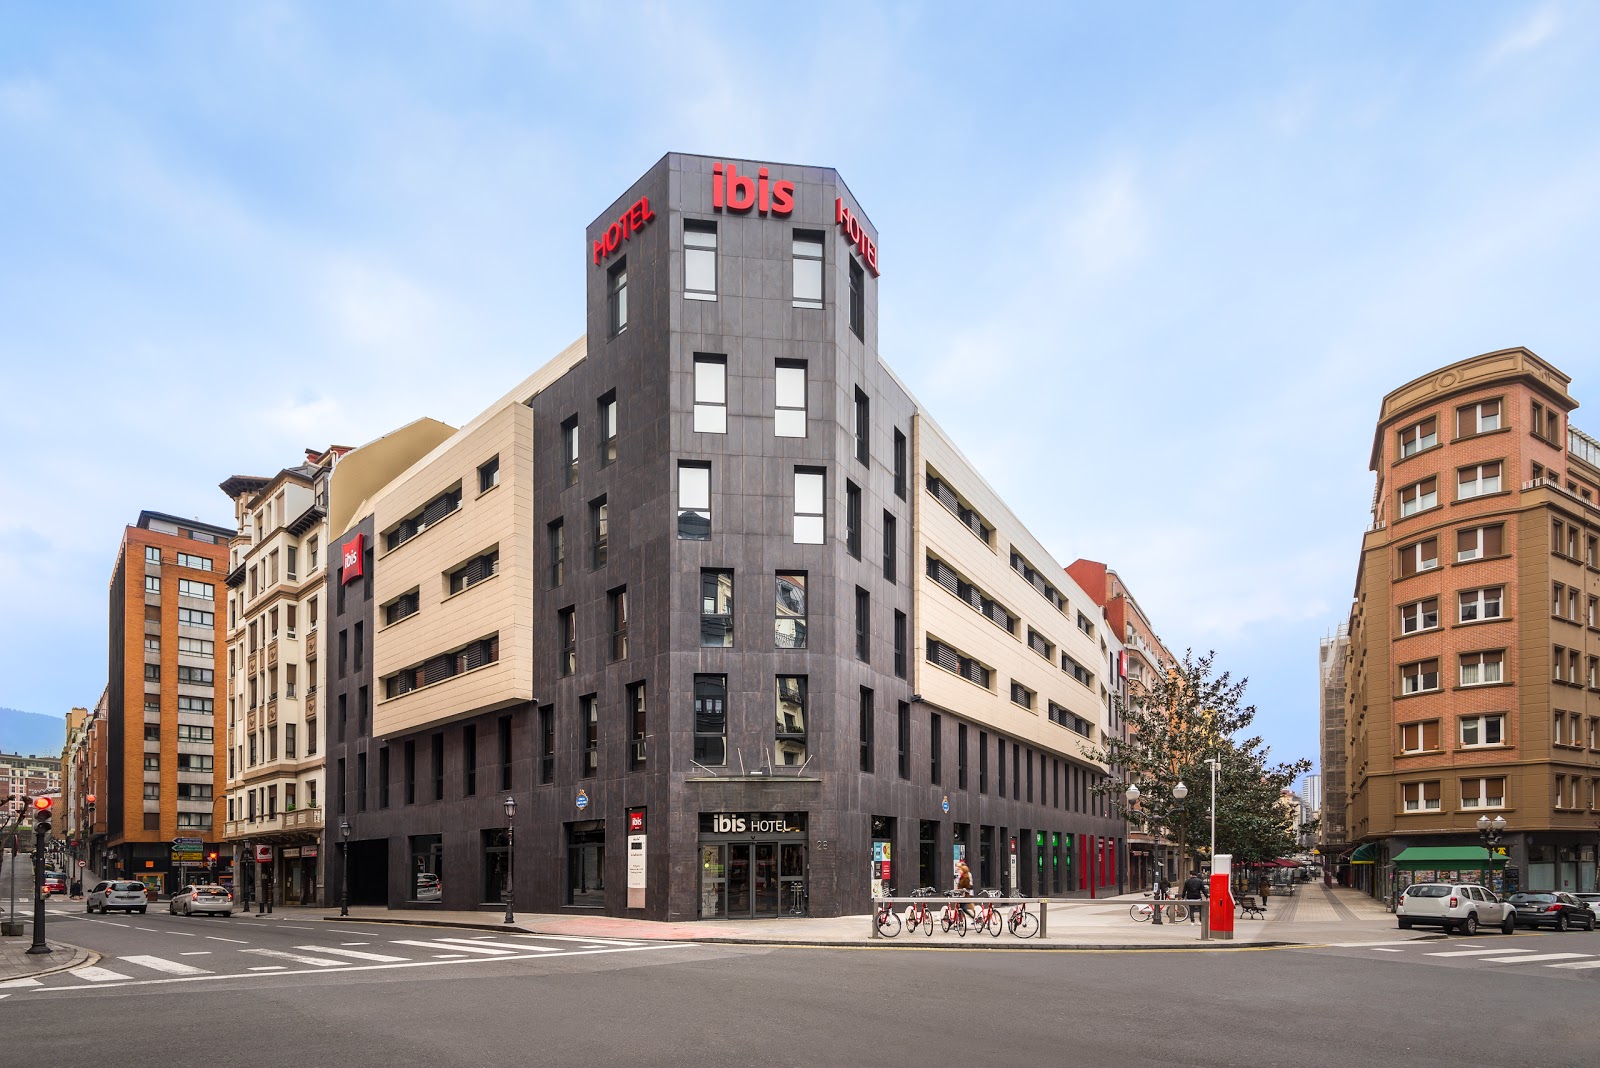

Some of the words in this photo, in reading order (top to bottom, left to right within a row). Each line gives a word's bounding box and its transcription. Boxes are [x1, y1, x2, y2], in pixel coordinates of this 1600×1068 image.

[713, 162, 795, 214] ibis
[593, 195, 656, 265] HOTEL
[835, 197, 880, 277] HOTEL
[344, 549, 357, 569] ibis
[632, 817, 642, 826] ibis
[713, 813, 746, 833] ibis
[751, 820, 791, 832] HOTEL
